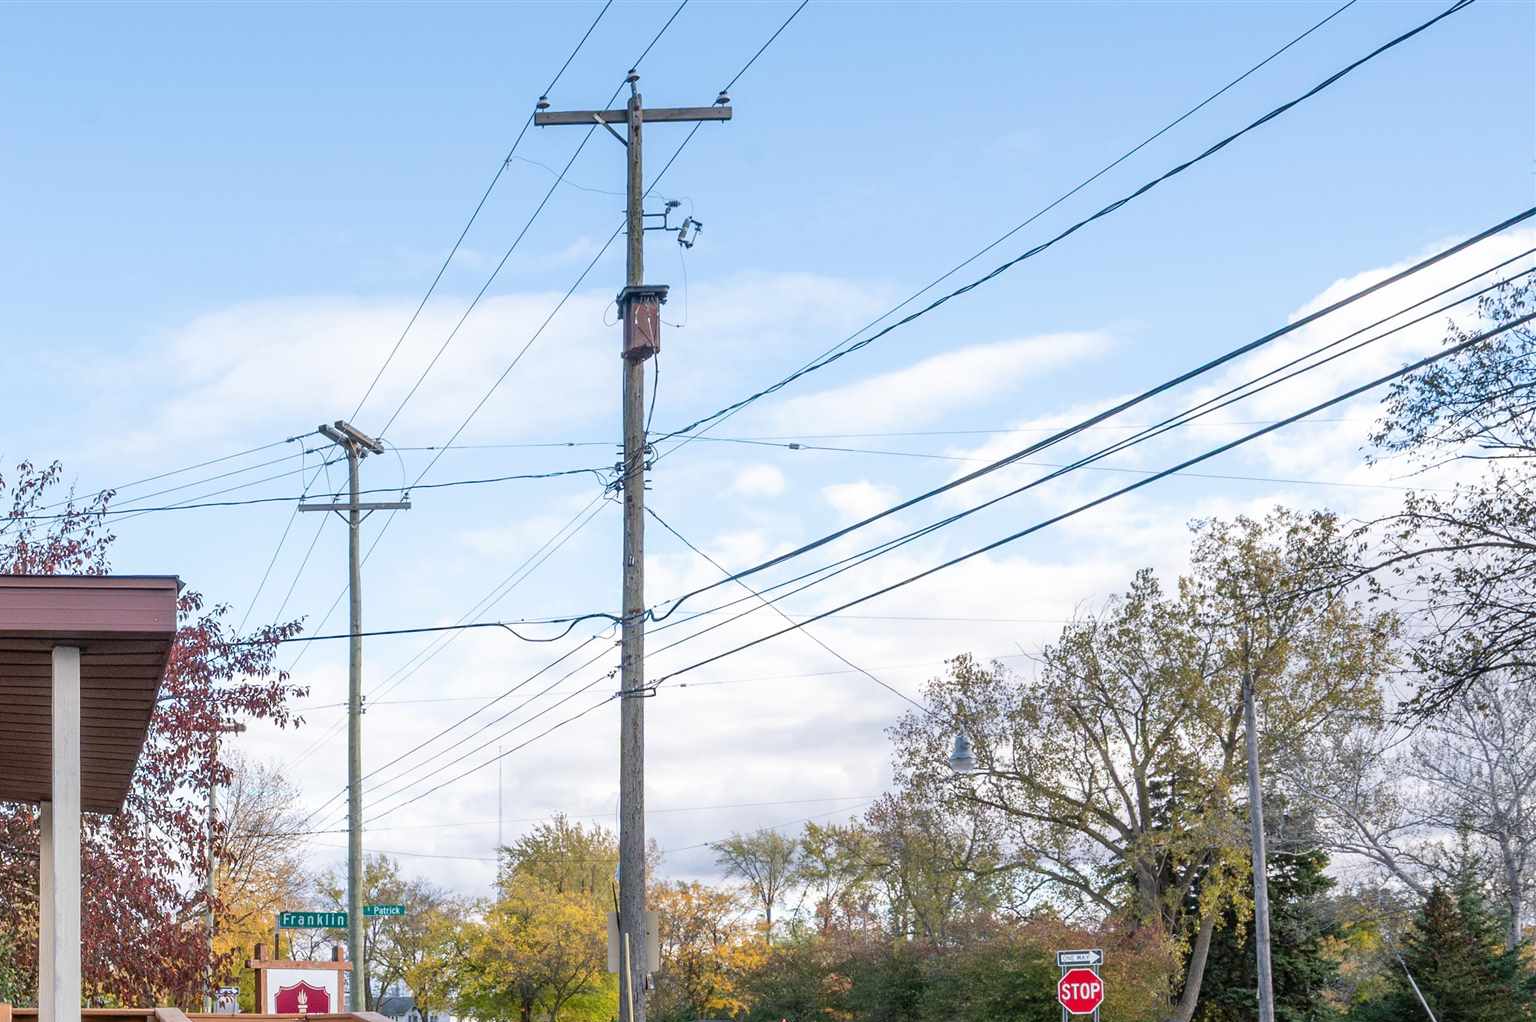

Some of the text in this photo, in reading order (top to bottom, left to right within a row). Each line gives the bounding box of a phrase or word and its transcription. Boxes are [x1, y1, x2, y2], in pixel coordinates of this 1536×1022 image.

[373, 905, 401, 915] Patrick
[283, 912, 345, 926] Franklin
[1061, 982, 1100, 1000] STOP
